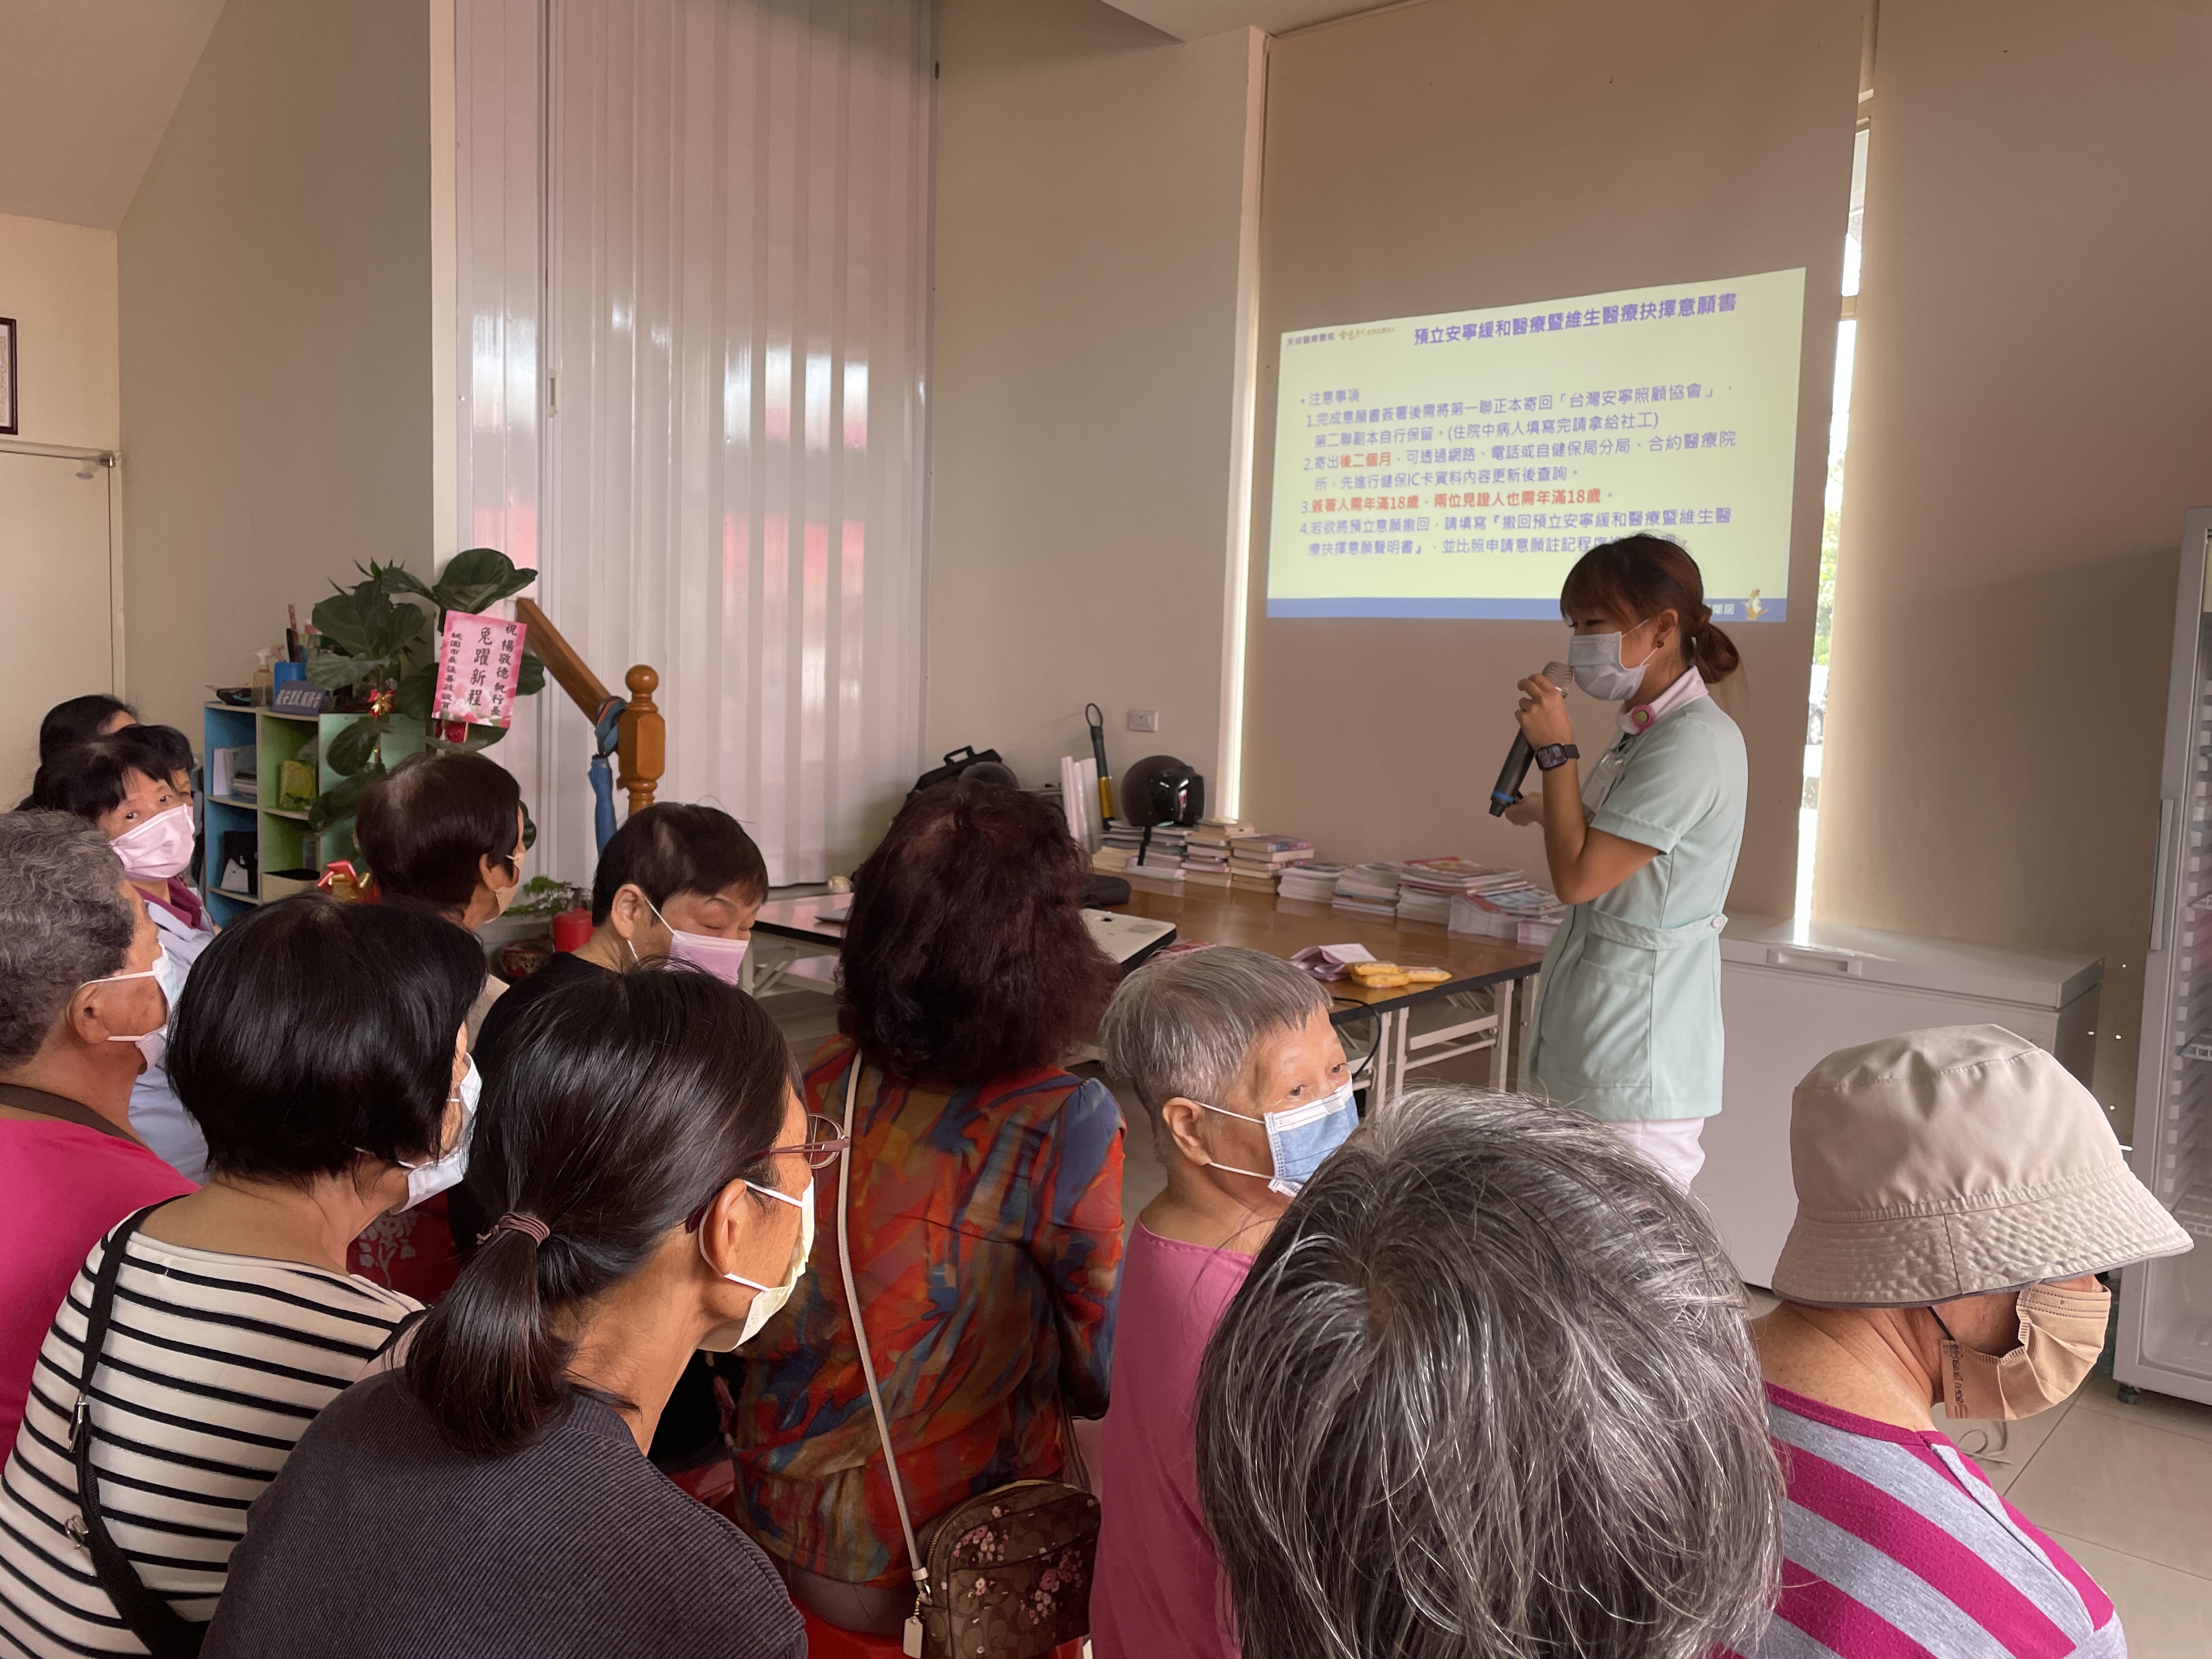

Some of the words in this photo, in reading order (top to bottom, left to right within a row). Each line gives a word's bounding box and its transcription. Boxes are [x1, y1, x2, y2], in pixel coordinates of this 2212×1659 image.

[1414, 292, 1737, 346] 預立安寧緩和醫療暨維生醫療抉擇意願書
[1308, 388, 1360, 407] 注意事項
